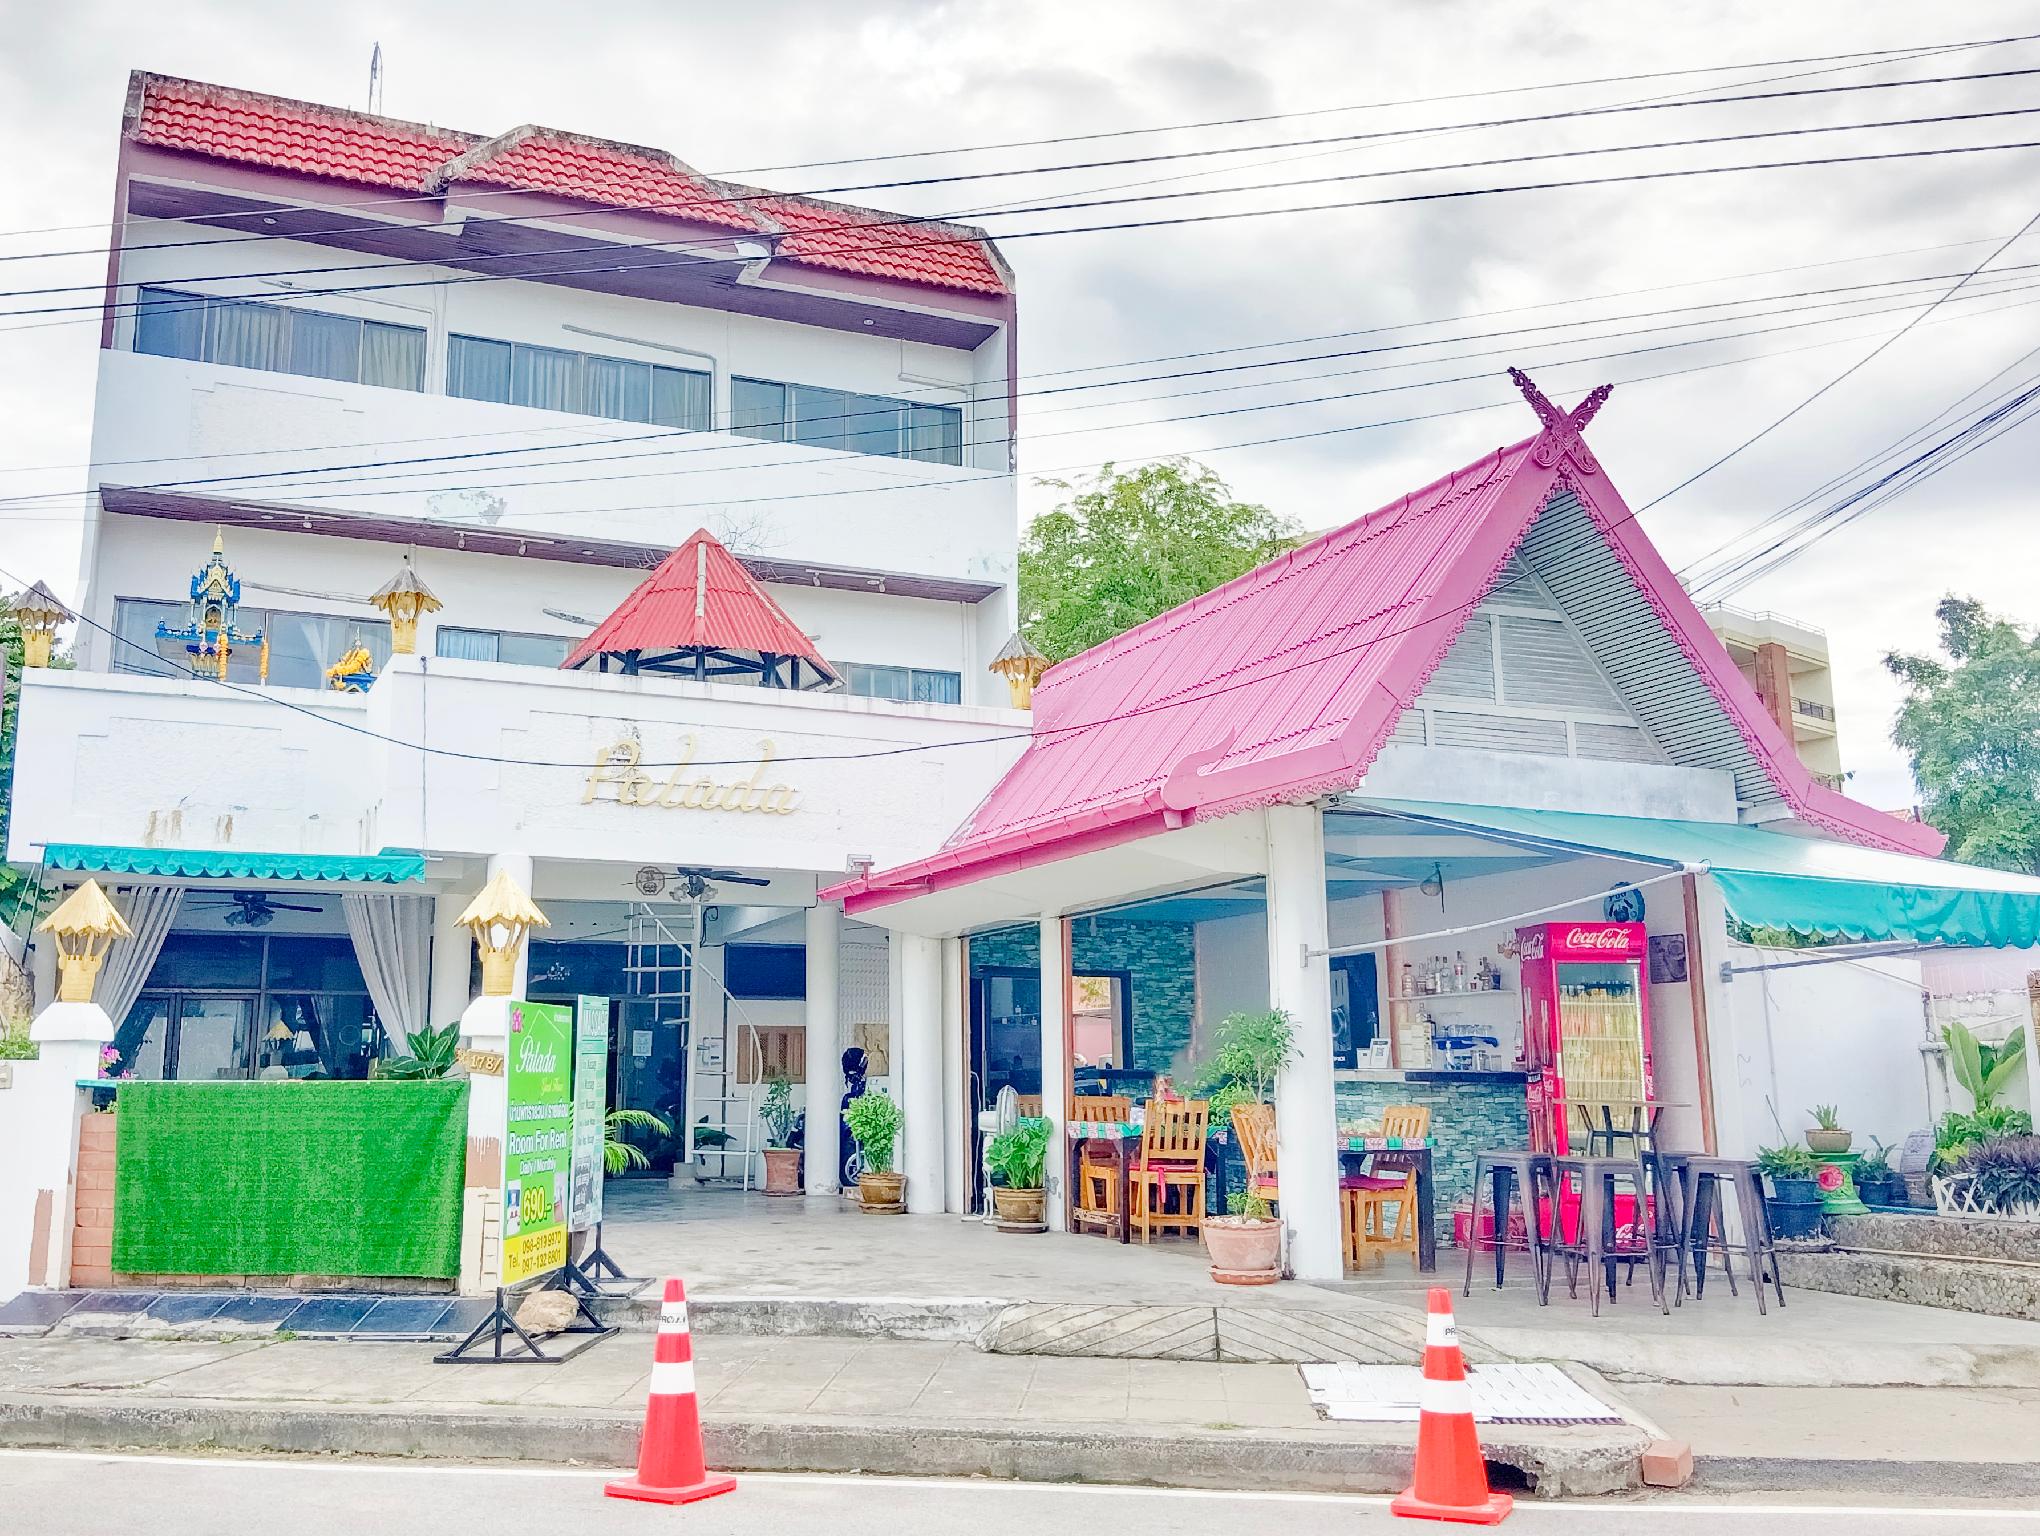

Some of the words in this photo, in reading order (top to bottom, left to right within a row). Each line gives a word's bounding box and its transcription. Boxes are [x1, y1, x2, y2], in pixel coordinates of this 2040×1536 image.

[581, 733, 800, 814] Palada
[516, 1036, 557, 1072] Palada
[509, 1132, 533, 1154] Room
[535, 1130, 548, 1151] For
[550, 1128, 567, 1149] Rent
